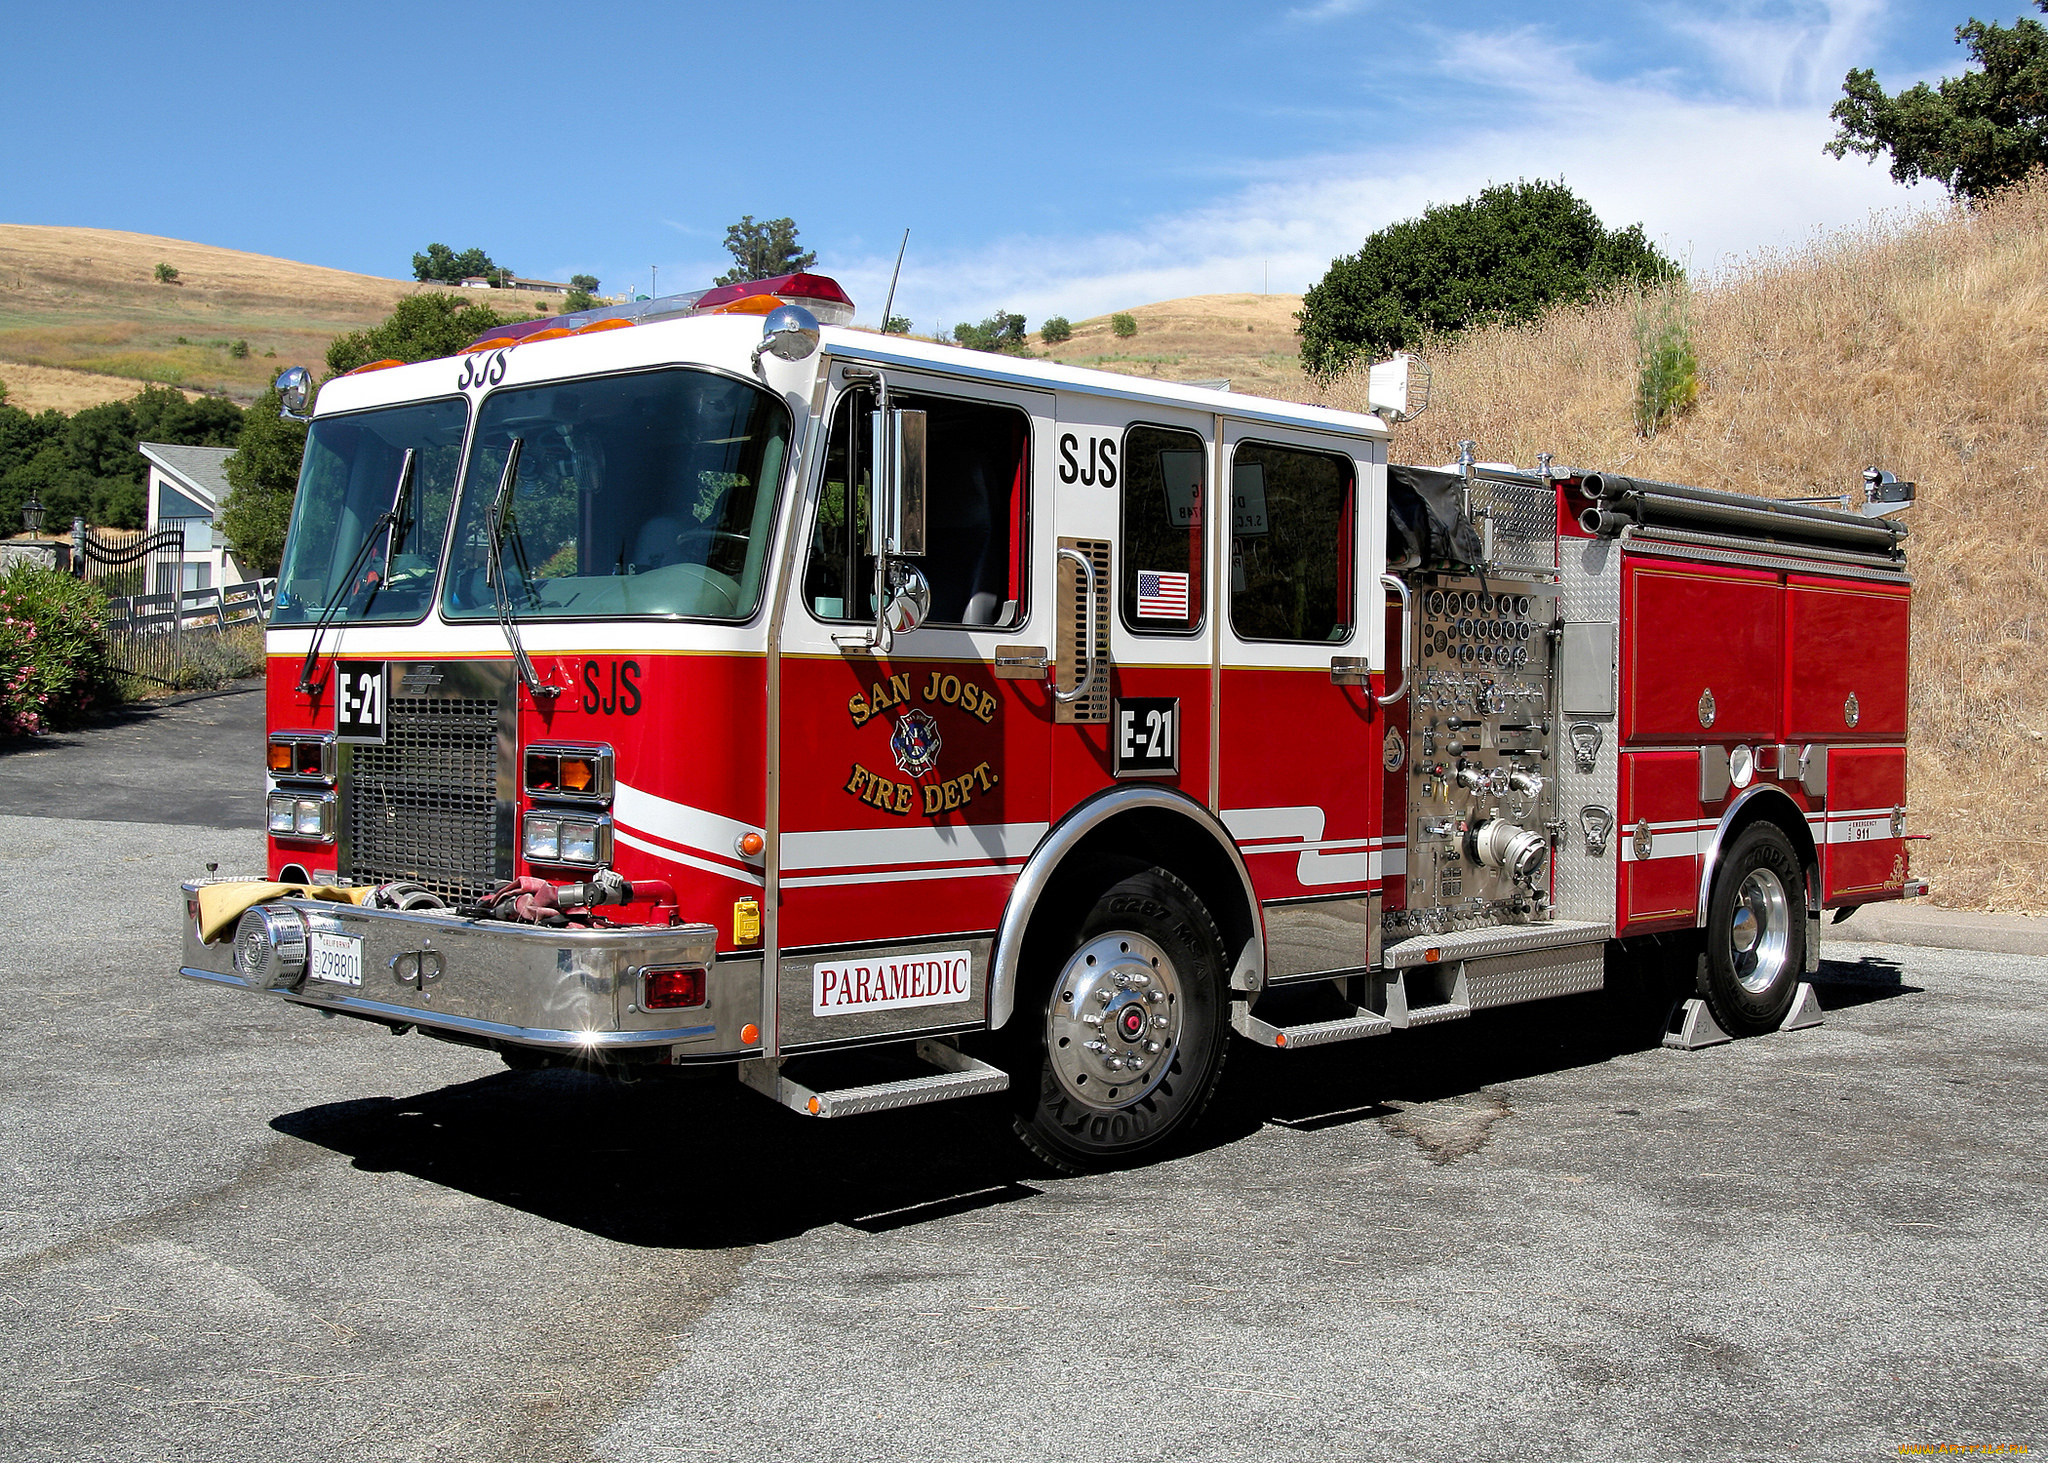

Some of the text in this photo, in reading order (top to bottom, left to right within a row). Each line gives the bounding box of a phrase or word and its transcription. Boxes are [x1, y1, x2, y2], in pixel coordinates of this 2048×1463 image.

[457, 346, 517, 391] SJS
[1058, 432, 1117, 489] SJS
[339, 673, 381, 725] E-21
[583, 660, 642, 716] SJS
[848, 671, 997, 728] SAN JOSE
[1120, 709, 1172, 758] E-21
[846, 761, 999, 815] FIRE DEPT.
[1852, 820, 1878, 828] EMERGENCY
[1856, 828, 1870, 840] 911
[321, 951, 360, 980] 298801
[322, 938, 351, 949] CALIFORNIA
[819, 958, 968, 1007] PARAMEDIC
